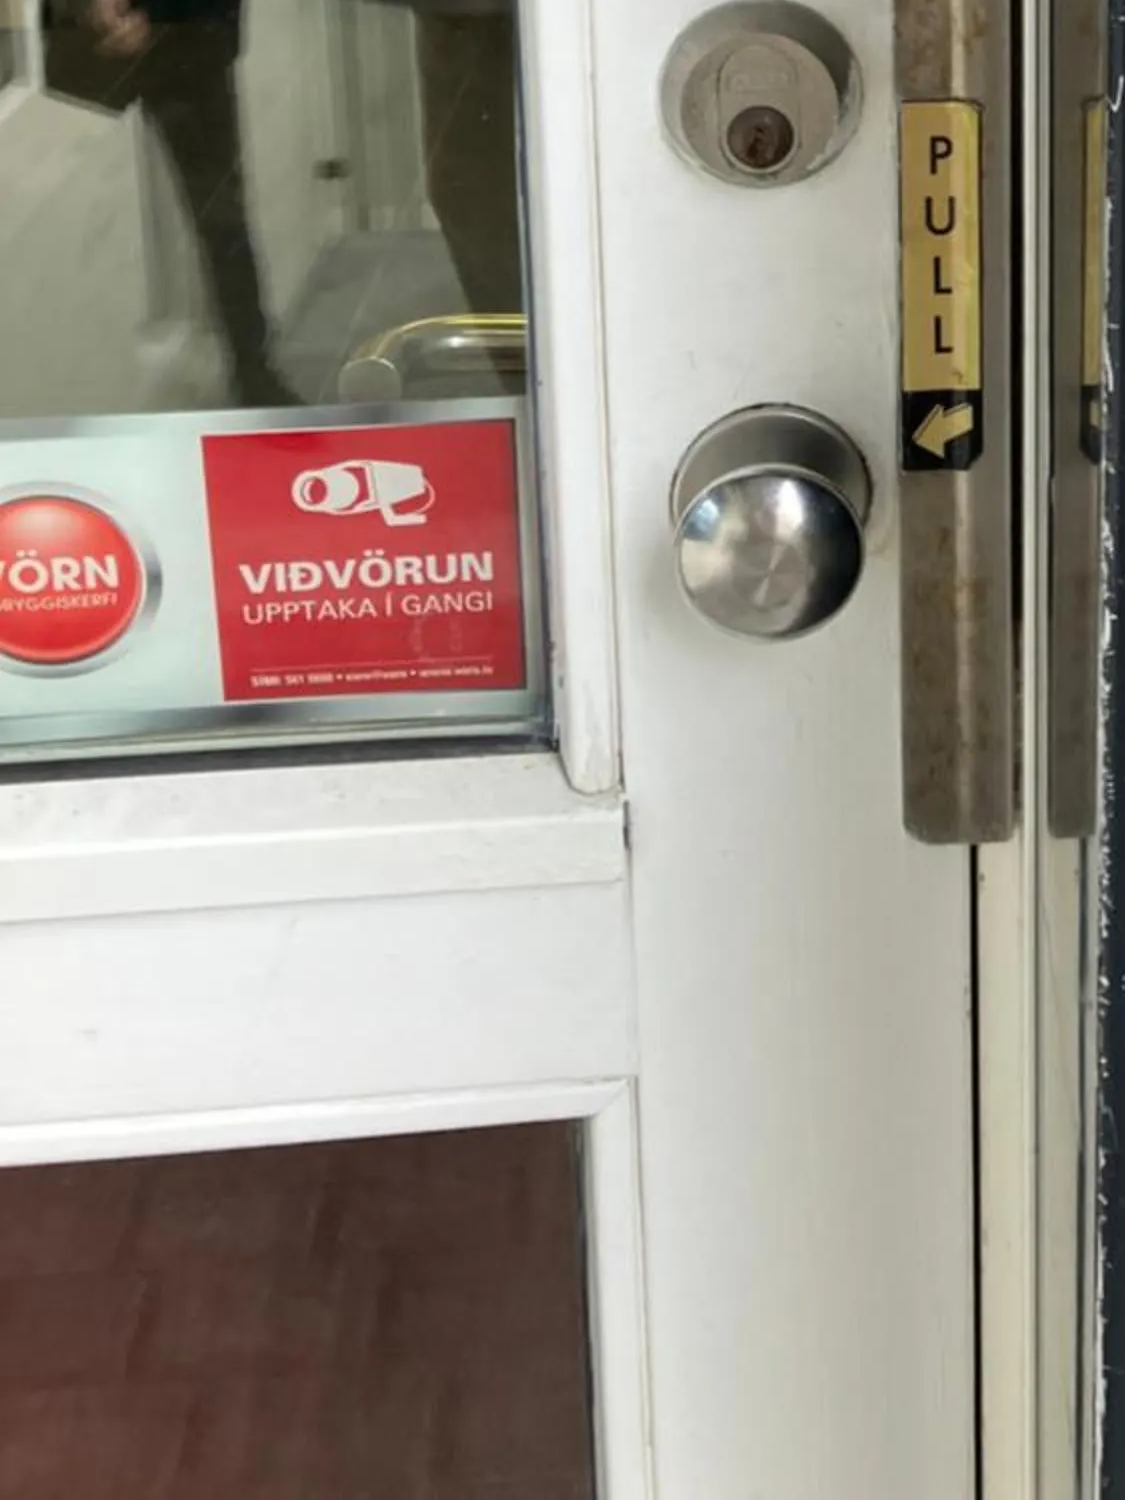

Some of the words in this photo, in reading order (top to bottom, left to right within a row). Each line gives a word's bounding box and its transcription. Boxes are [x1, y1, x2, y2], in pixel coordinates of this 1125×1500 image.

[924, 135, 956, 354] PULL
[0, 548, 119, 595] ÖRN
[238, 548, 494, 595] VIÐVÖRUN
[242, 597, 378, 625] UPPTAKA
[401, 589, 494, 617] GANGI
